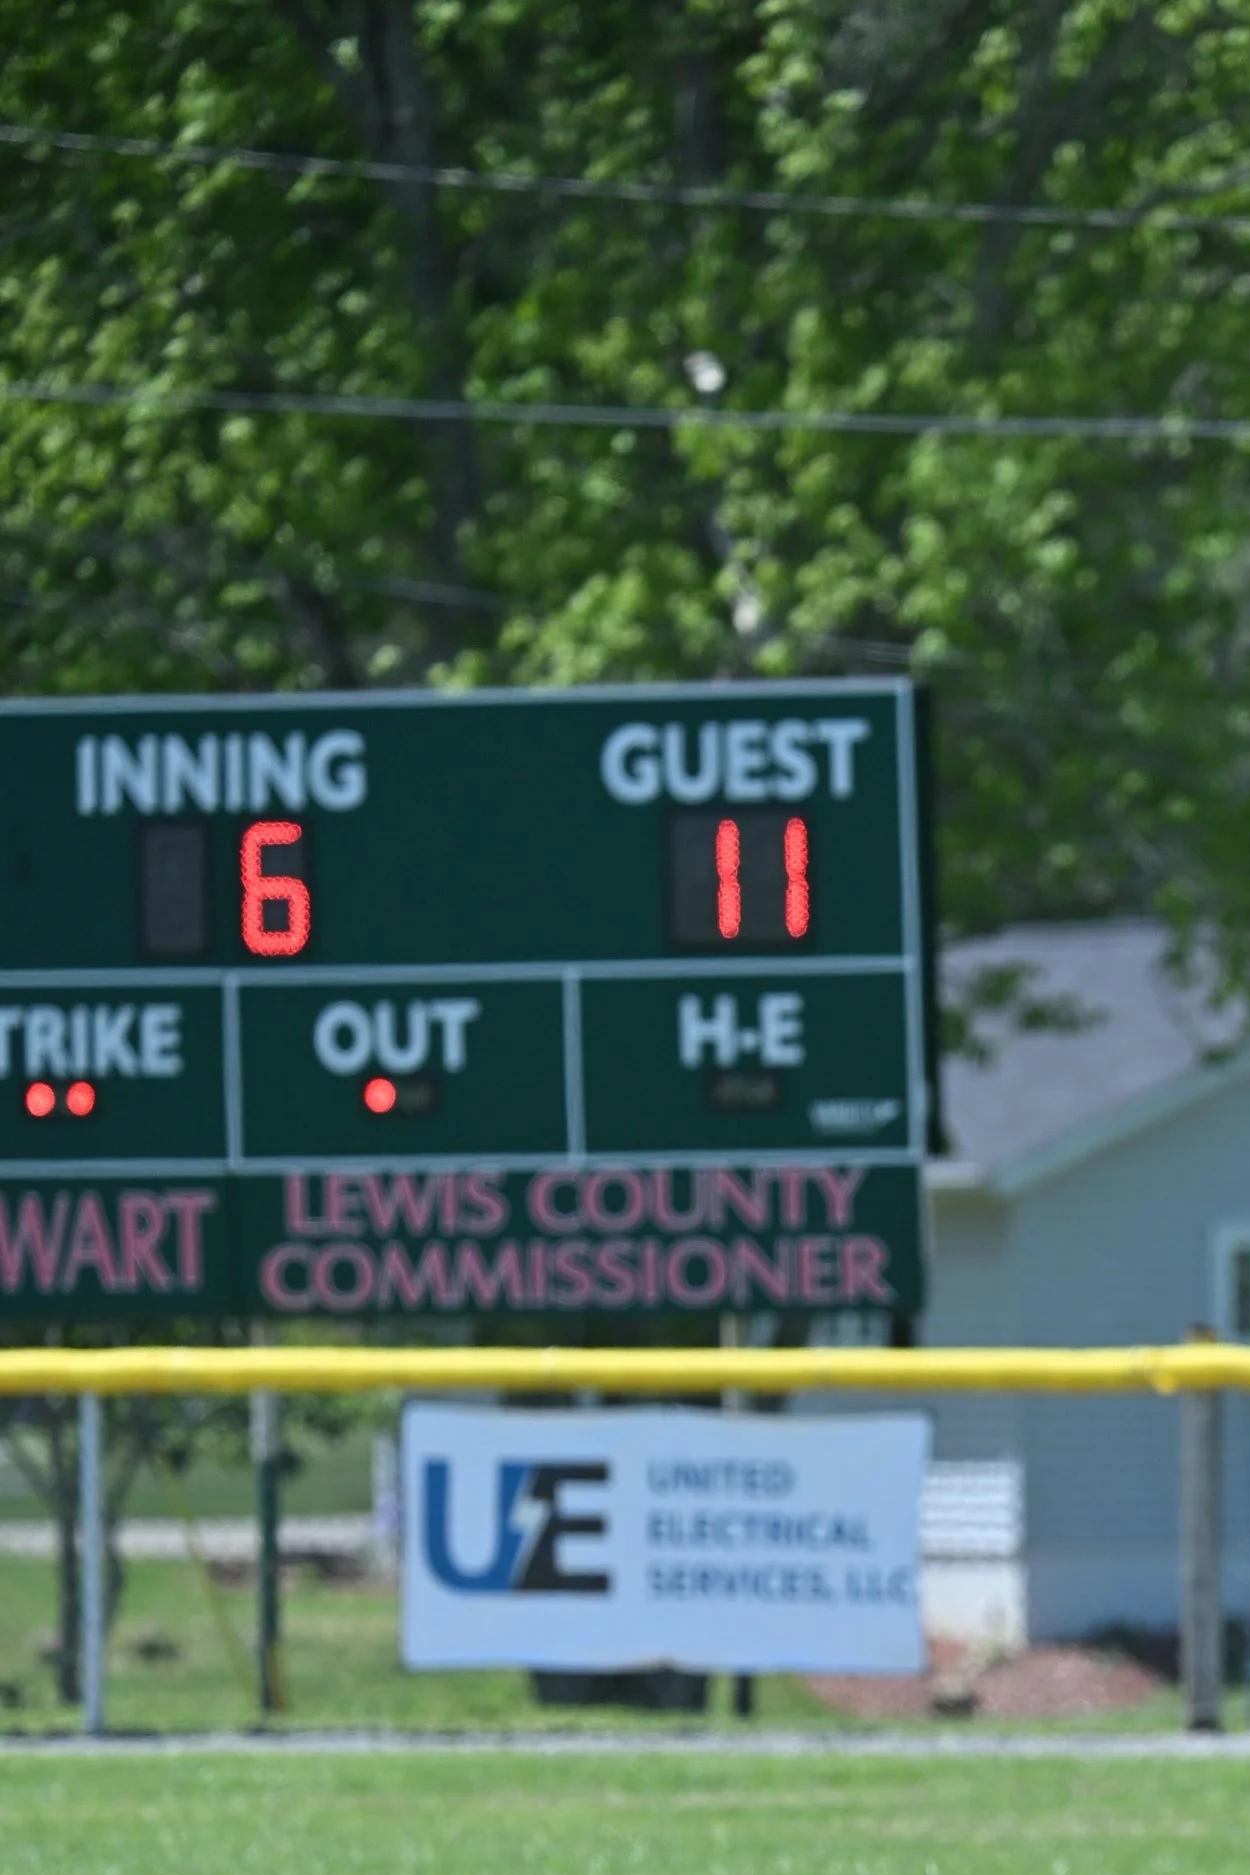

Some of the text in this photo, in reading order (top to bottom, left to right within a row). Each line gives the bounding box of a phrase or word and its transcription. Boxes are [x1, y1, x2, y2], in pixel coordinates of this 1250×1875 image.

[76, 730, 366, 814] INNING
[600, 718, 868, 804] GUEST
[240, 821, 311, 956] 6
[715, 817, 810, 939] 11
[313, 998, 481, 1075] OUT
[284, 1165, 868, 1236] LEWIS COUNTY
[0, 1189, 215, 1293] WART
[259, 1236, 895, 1309] COMMISSIONER
[648, 1460, 796, 1497] UNITED
[648, 1511, 872, 1549] ELECTRICAL
